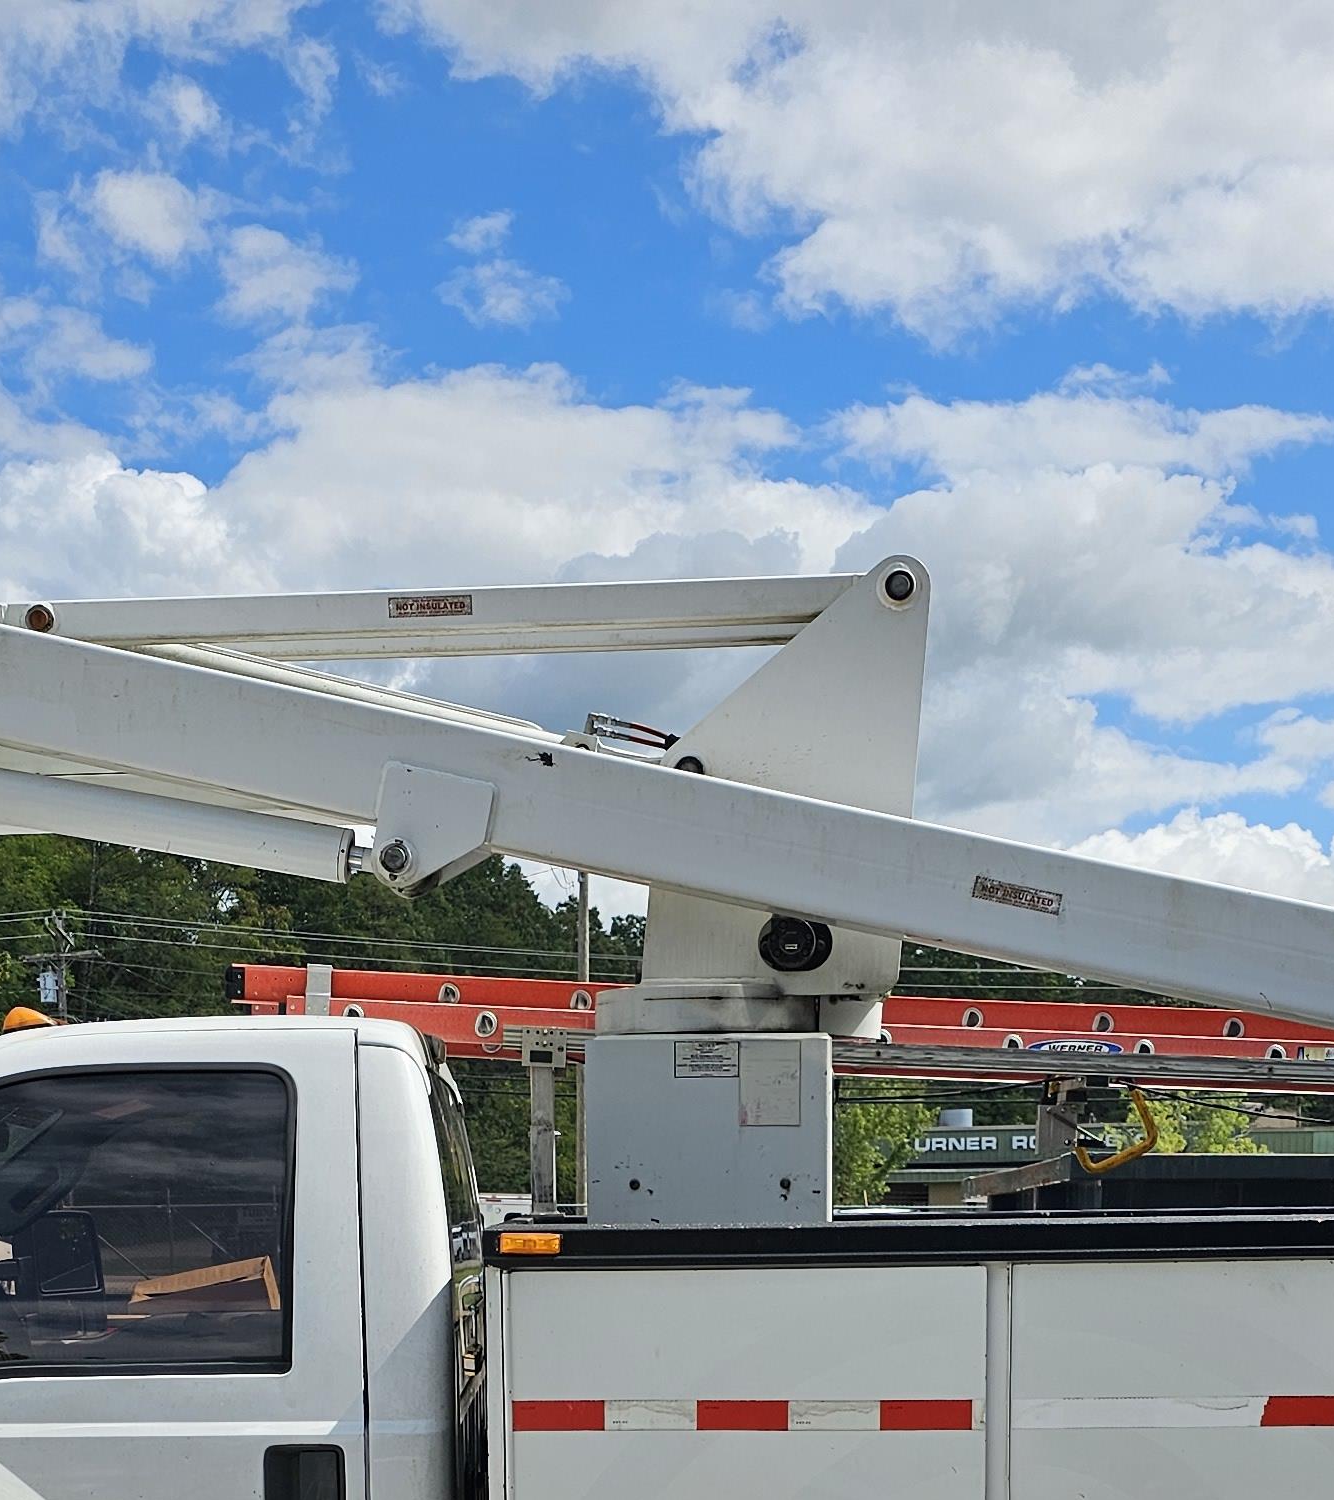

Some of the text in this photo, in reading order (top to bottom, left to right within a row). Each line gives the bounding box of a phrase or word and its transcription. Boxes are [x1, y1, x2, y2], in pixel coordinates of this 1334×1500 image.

[396, 601, 465, 611] NOT INSULATED
[981, 884, 999, 895] NOT
[1002, 889, 1053, 907] INSULATED
[914, 1136, 997, 1151] URNER
